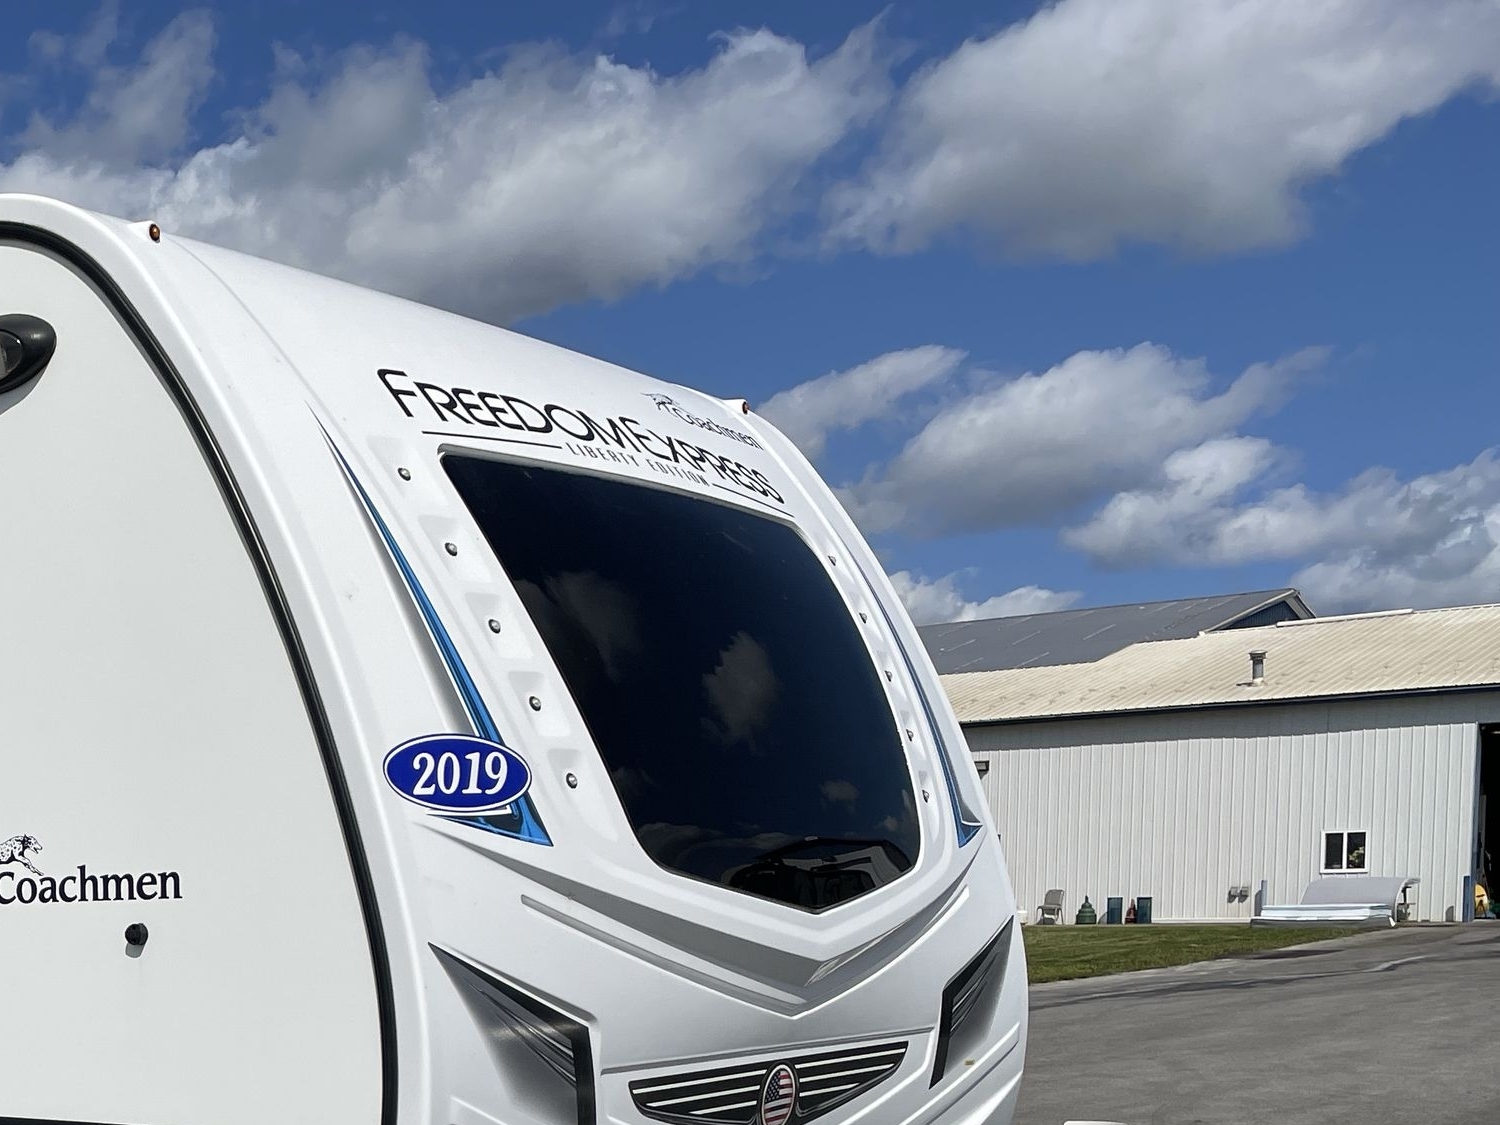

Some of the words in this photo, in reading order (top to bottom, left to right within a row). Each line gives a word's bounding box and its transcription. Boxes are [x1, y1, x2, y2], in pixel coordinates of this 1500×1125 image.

[672, 407, 764, 451] Coachmen
[565, 442, 640, 467] LIBERTY
[646, 458, 710, 487] EDITION
[412, 751, 508, 796] 2019
